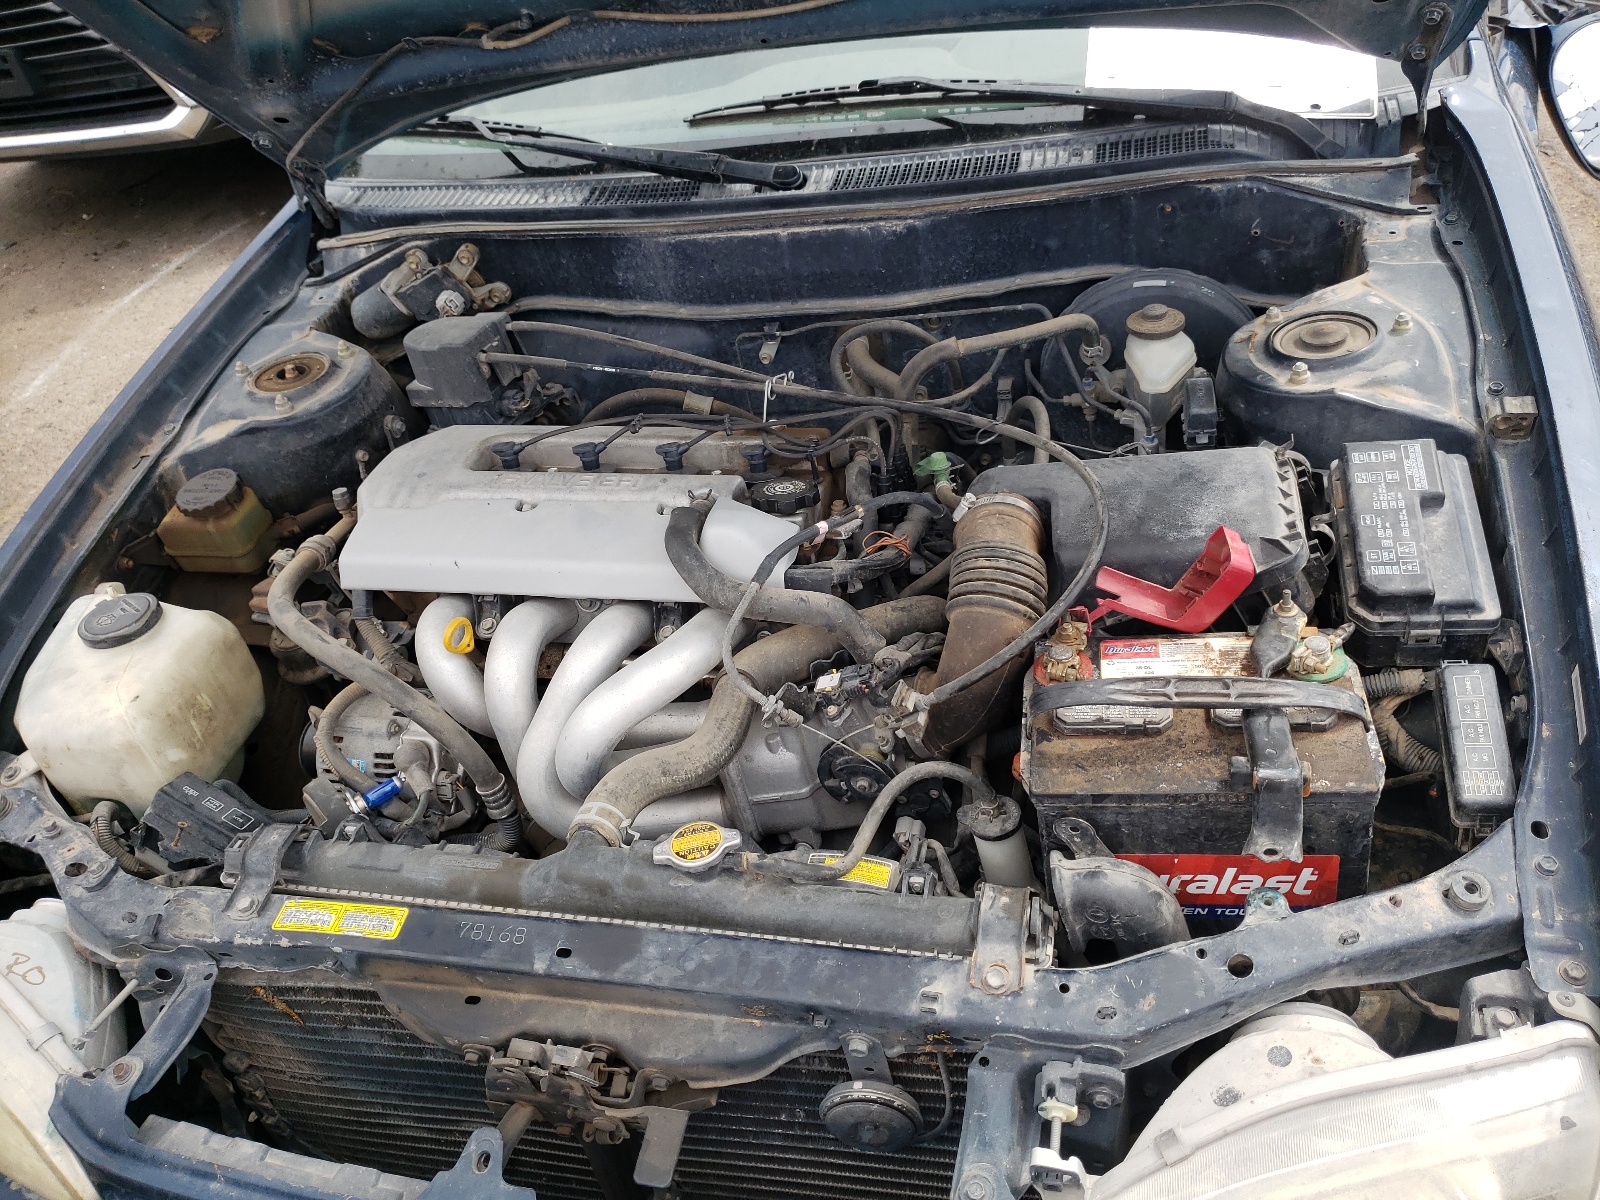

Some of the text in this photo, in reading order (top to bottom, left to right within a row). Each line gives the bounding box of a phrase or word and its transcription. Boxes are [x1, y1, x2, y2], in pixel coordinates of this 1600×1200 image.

[1105, 644, 1156, 654] Duralast
[679, 843, 716, 856] CAUTION
[459, 921, 527, 945] 78168
